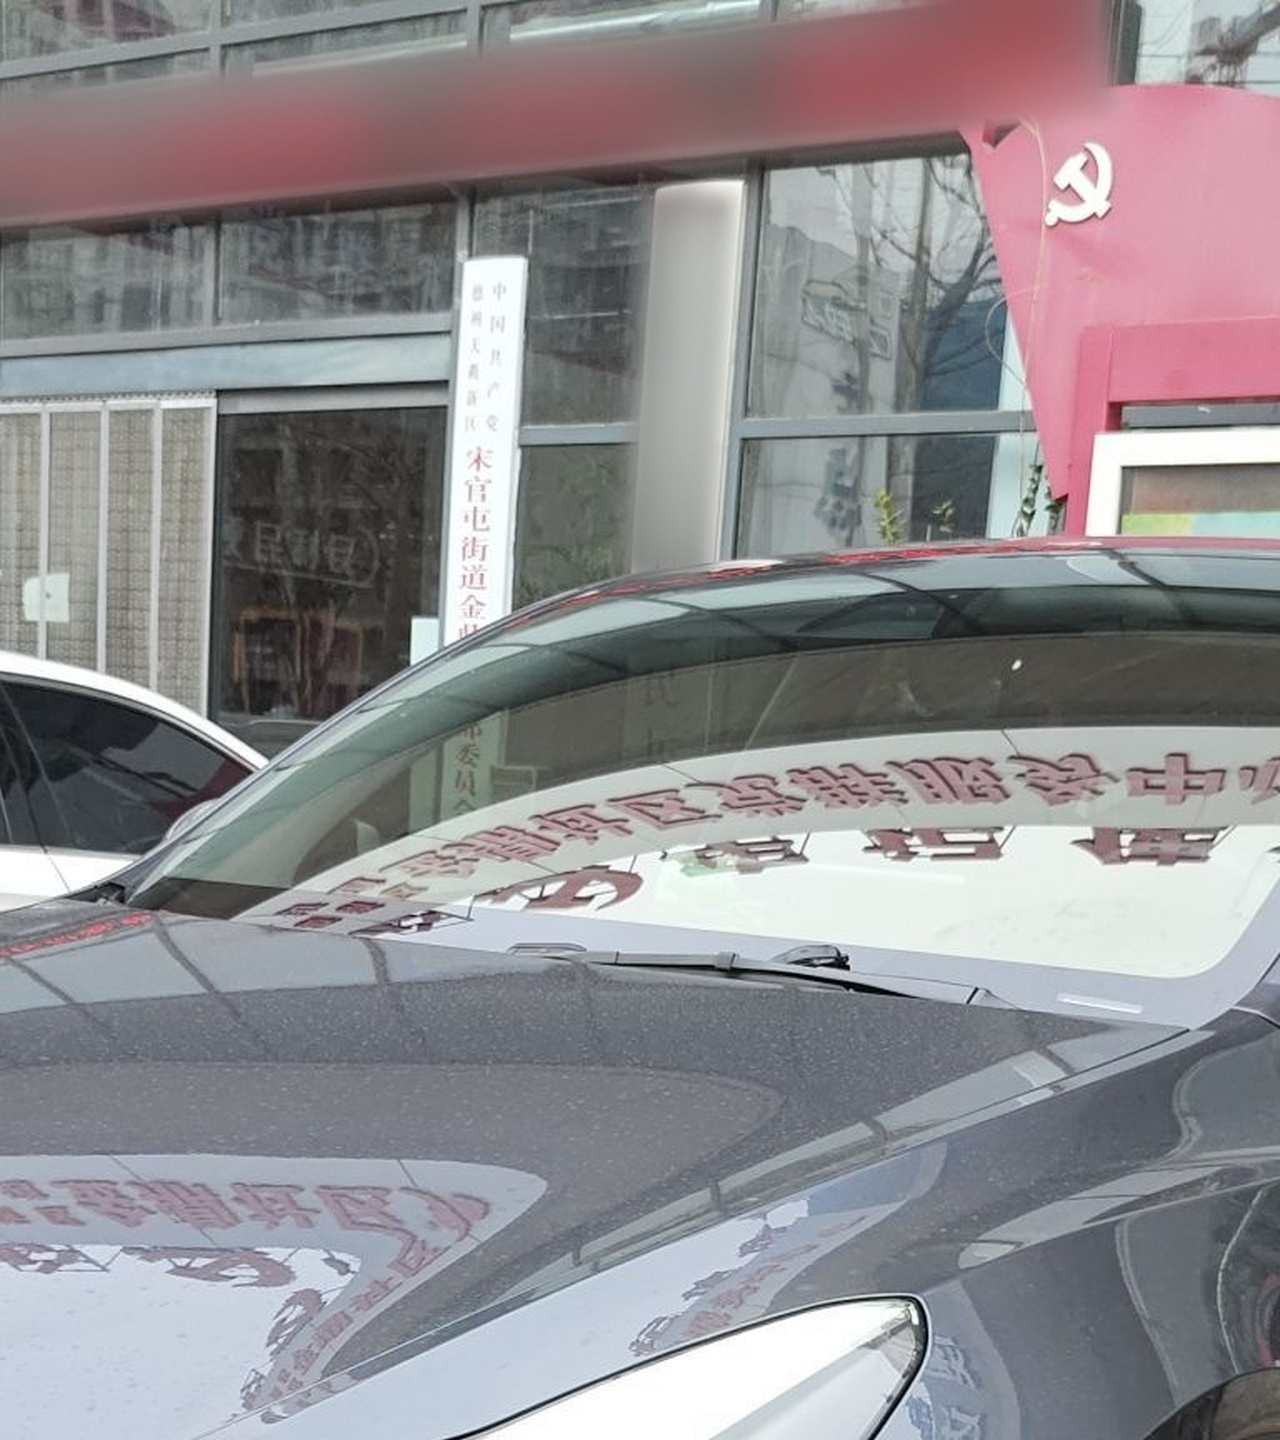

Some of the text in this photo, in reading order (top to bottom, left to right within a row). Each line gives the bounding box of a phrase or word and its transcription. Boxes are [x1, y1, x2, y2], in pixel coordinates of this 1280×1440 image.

[484, 281, 508, 433] 中国共产党
